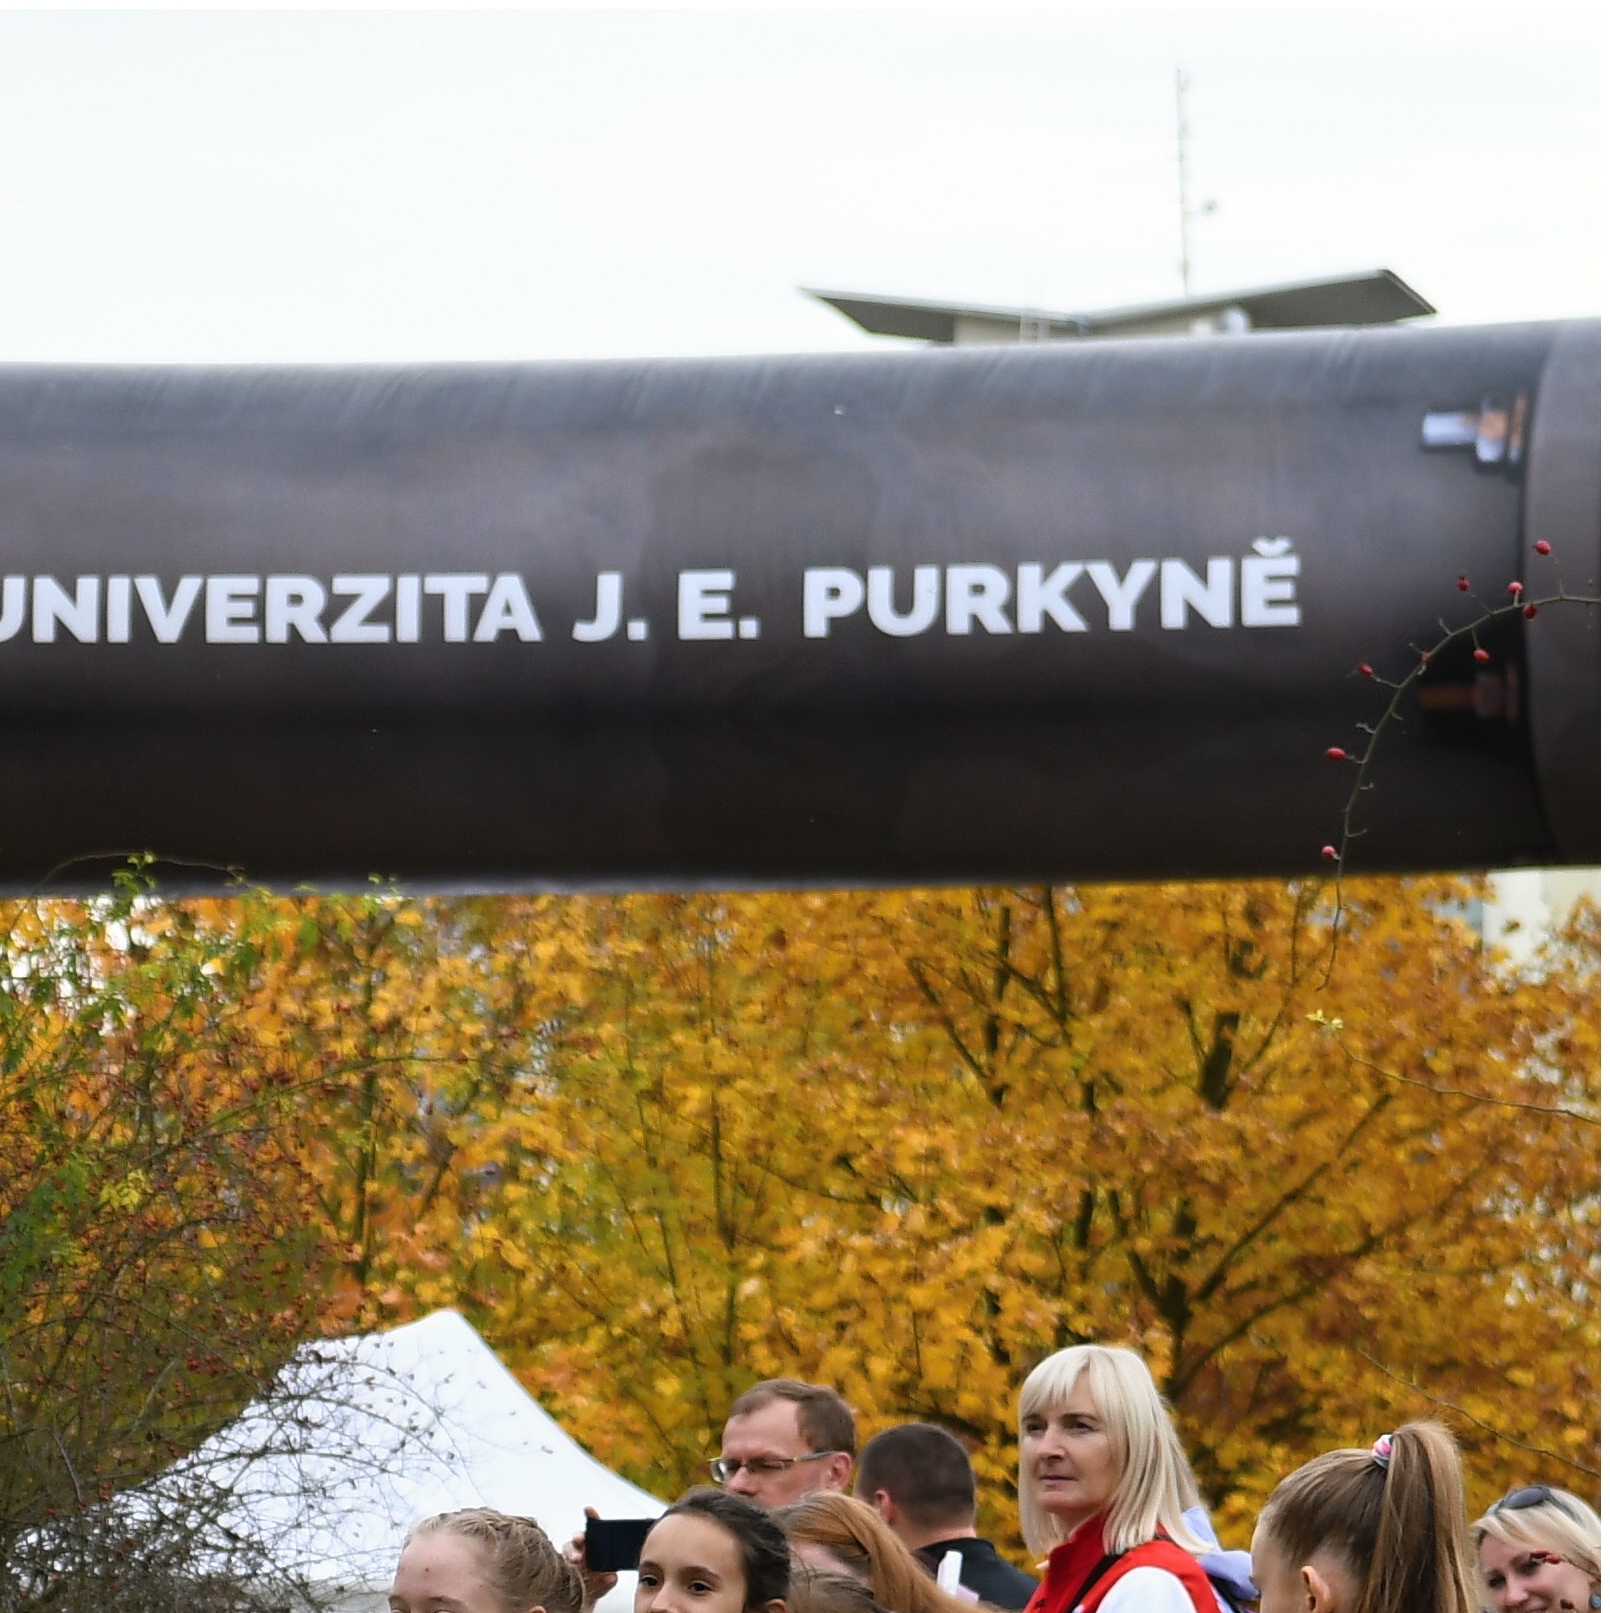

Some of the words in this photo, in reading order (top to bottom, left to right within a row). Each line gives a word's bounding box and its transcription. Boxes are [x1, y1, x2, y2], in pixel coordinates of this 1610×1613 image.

[572, 570, 649, 642] J.
[678, 570, 760, 640] E.
[802, 538, 1301, 637] PURKYNĚ
